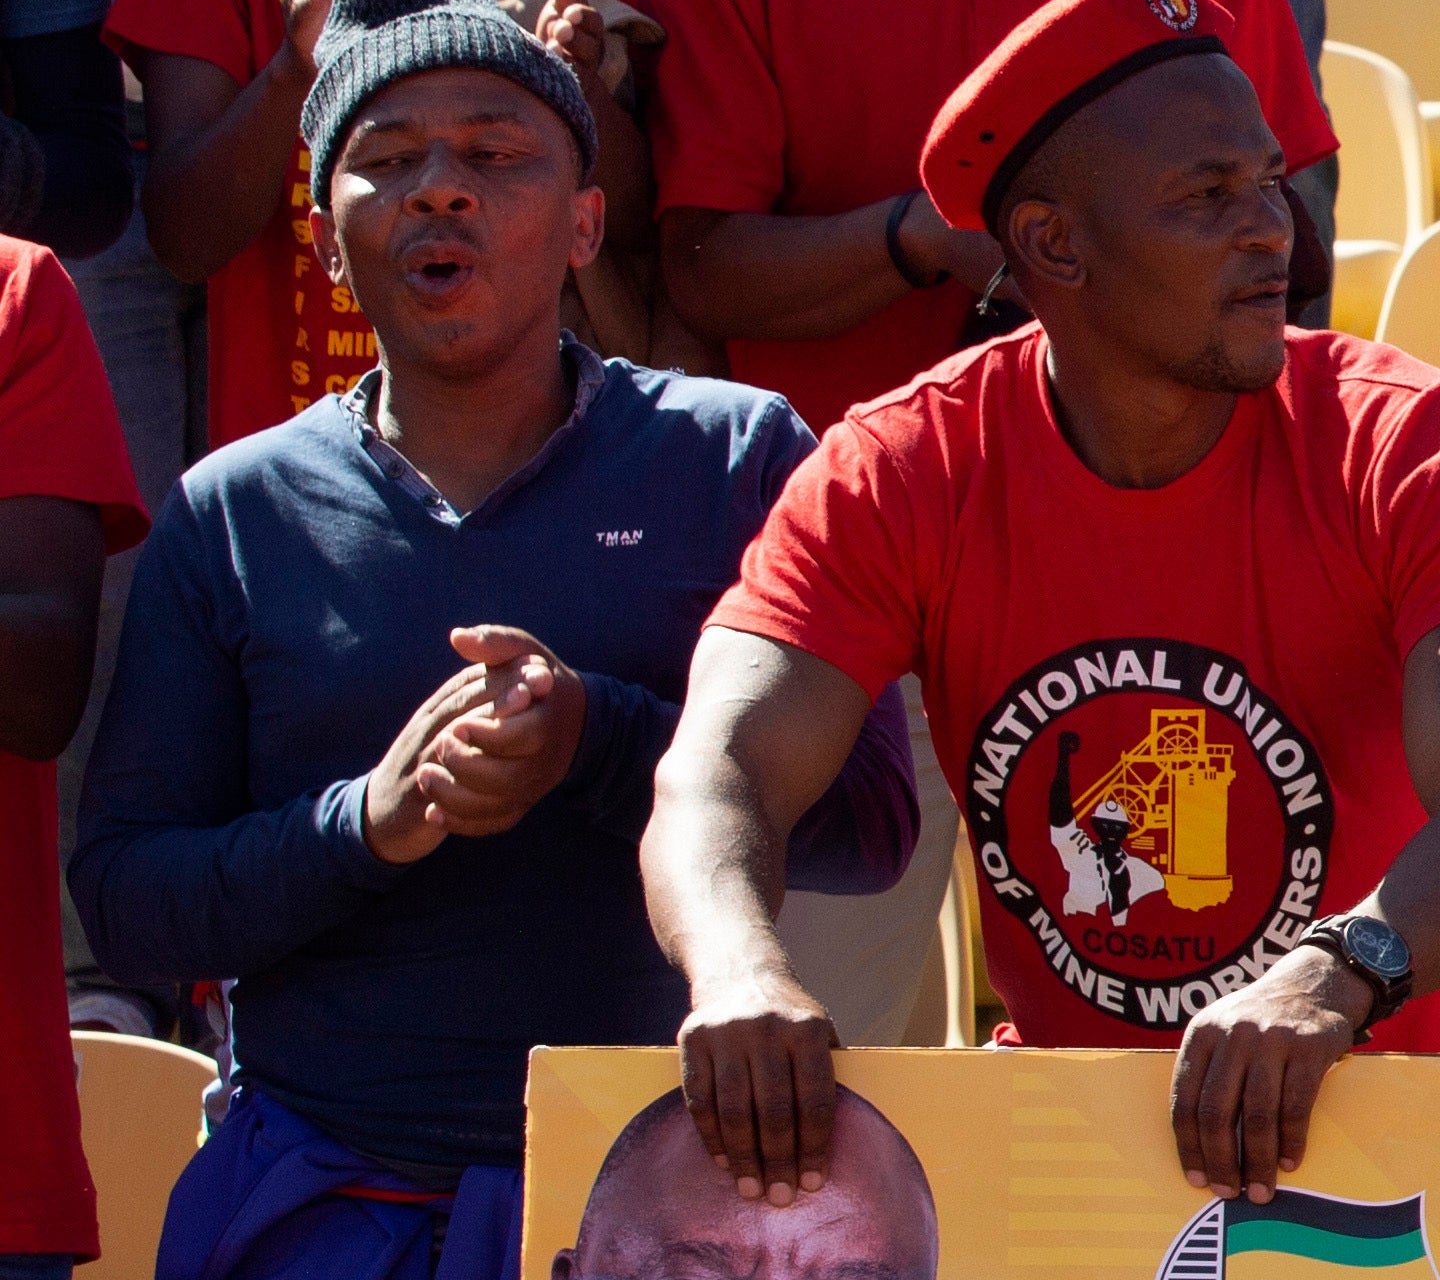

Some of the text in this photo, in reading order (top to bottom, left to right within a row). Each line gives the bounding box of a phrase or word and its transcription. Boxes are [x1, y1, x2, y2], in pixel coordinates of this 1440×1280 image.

[974, 650, 1324, 817] NATIONAL UNION
[981, 842, 1035, 900] OF
[1028, 905, 1128, 1015] MINE
[1083, 928, 1215, 962] COSATU
